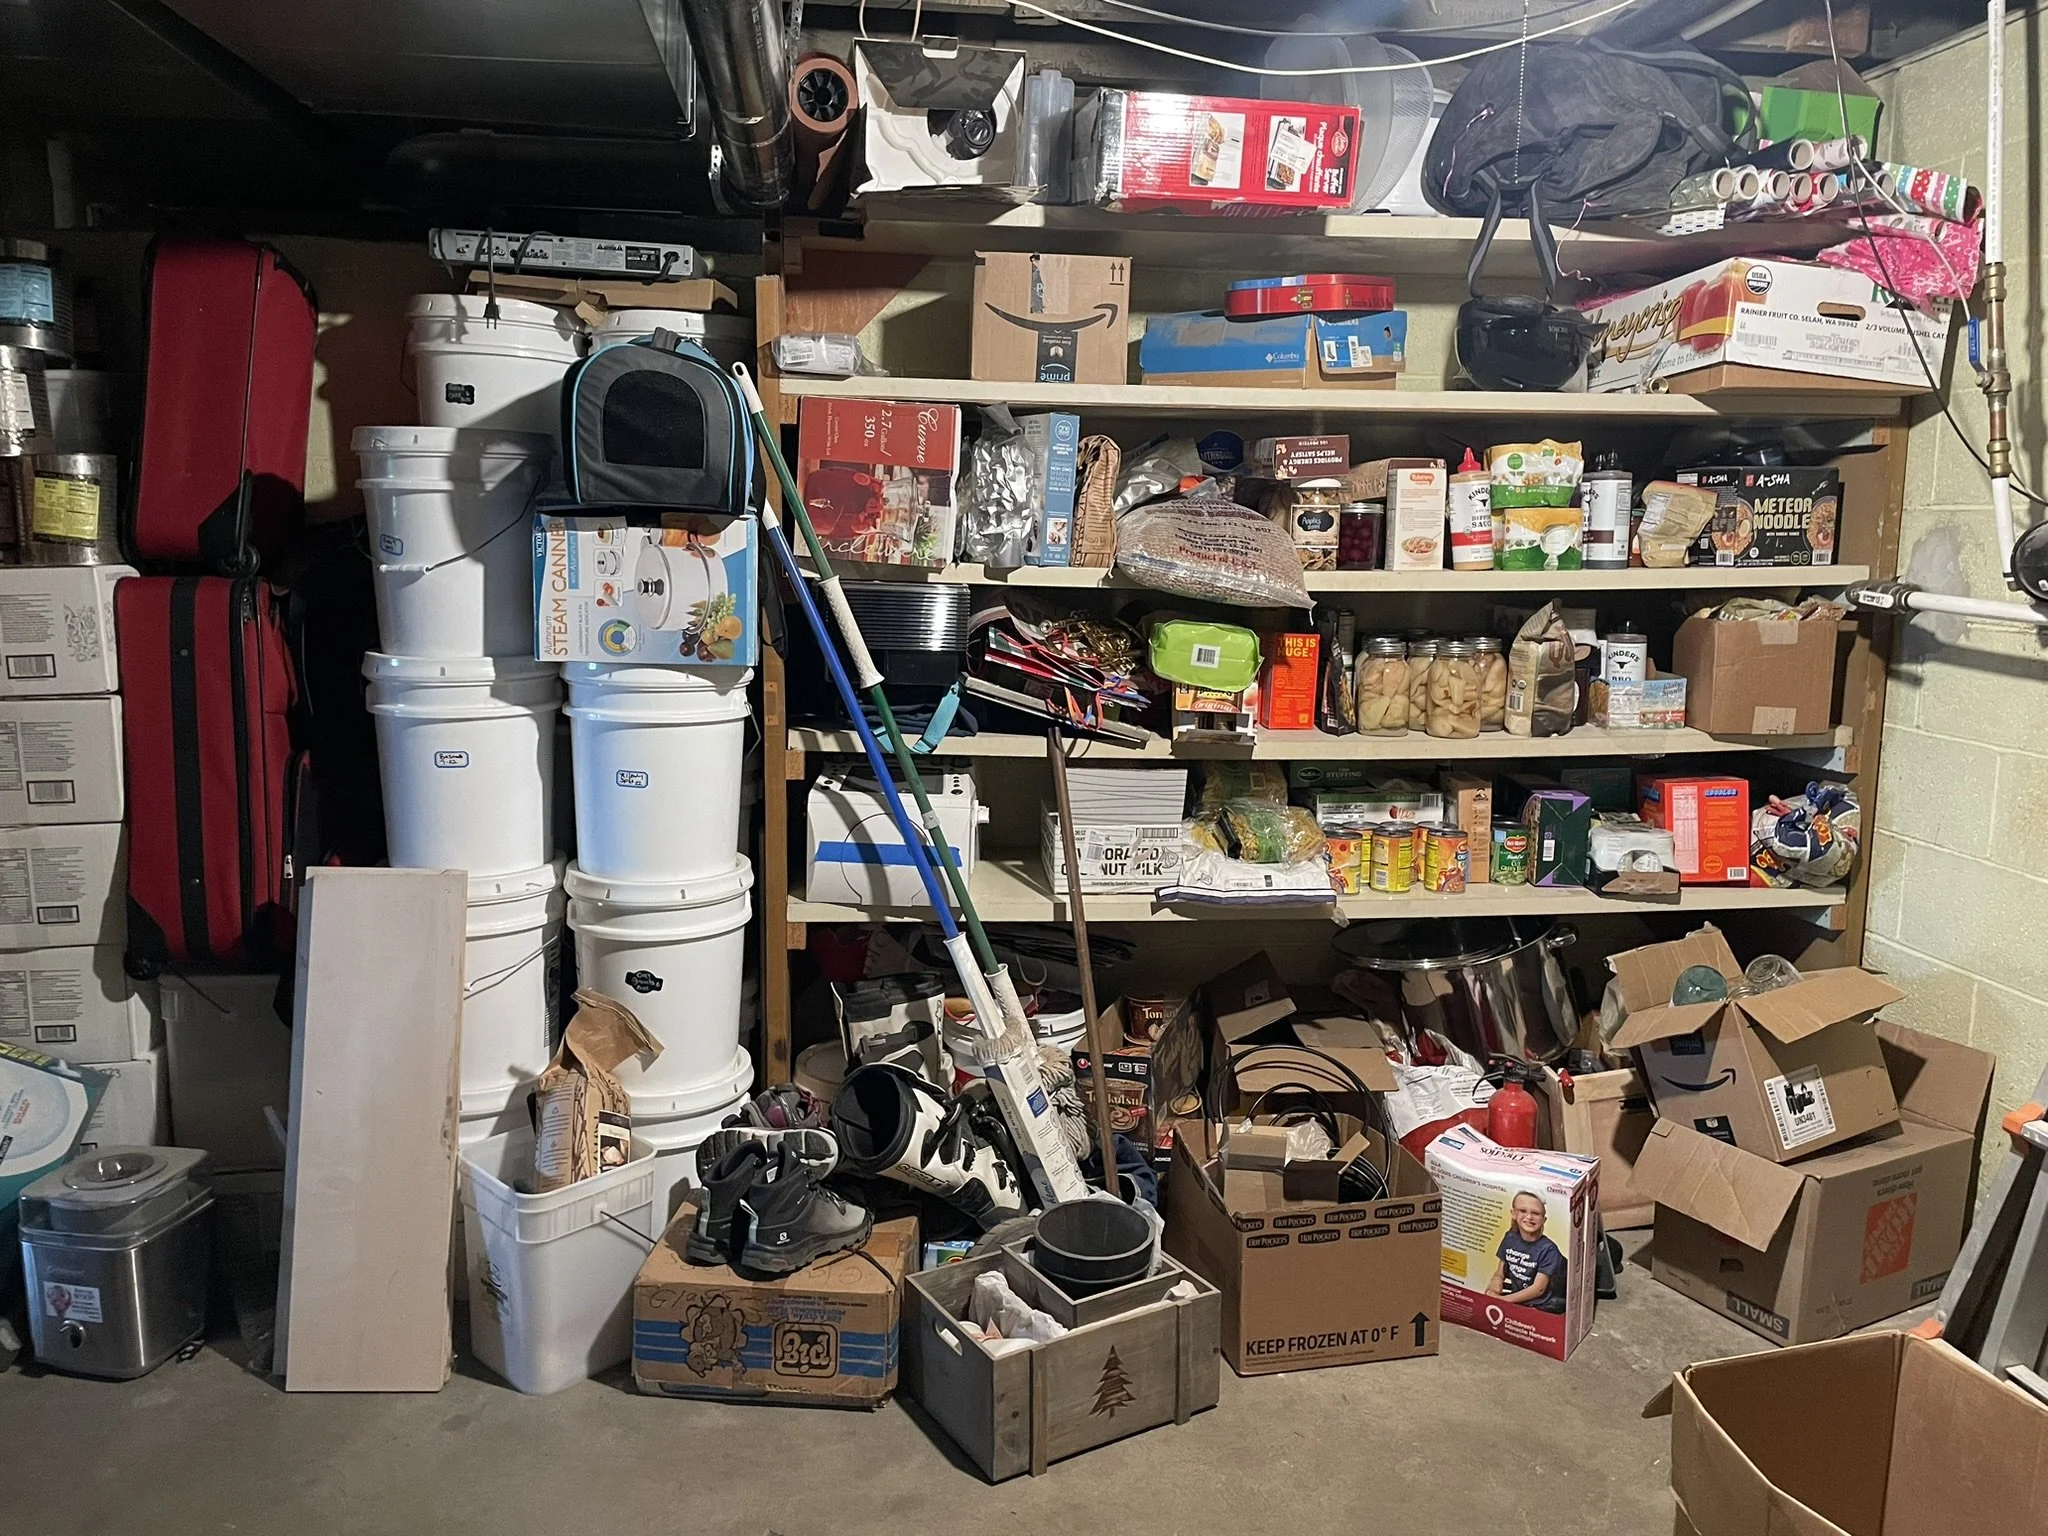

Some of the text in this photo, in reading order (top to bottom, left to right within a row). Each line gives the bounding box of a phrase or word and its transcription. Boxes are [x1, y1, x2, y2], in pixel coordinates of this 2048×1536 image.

[1313, 121, 1328, 193] Plaque chauffante
[1322, 168, 1331, 194] Server
[1329, 168, 1339, 194] Buffet
[1752, 272, 1767, 281] USDA
[1740, 306, 1766, 318] RAINIER
[1768, 310, 1788, 320] FRUIT
[1789, 313, 1799, 322] CO.
[1801, 315, 1824, 327] SELAH,
[1825, 317, 1836, 327] WA
[1866, 323, 1946, 341] 2/3 VOLUME USHEL CAT.
[1273, 352, 1299, 361] Columbia
[1040, 371, 1071, 383] prime
[864, 415, 876, 439] 350
[881, 409, 893, 428] 2.7
[917, 407, 940, 465] Curve
[1289, 457, 1313, 465] ENERGY
[1290, 449, 1336, 458] HELPS SATISFY
[1313, 456, 1342, 464] PROVIDES
[1707, 474, 1728, 485] A-SHA
[1756, 473, 1791, 488] A-SHA
[1754, 497, 1813, 514] METEOR
[1471, 521, 1492, 529] SAUC
[1753, 513, 1812, 530] NOODLE
[1179, 546, 1217, 562] Product
[548, 521, 568, 656] STEAM CANNER
[544, 615, 553, 655] Aluminum
[1279, 637, 1317, 648] THIS IS
[1193, 700, 1234, 712] Original
[1794, 1112, 1817, 1128] UN3481
[1452, 1173, 1481, 1186] CHILDREN'S
[1482, 1182, 1507, 1193] HOSPITAL
[1731, 1296, 1785, 1333] SMALL
[1504, 1316, 1536, 1332] Children's
[1246, 1325, 1399, 1356] KEEP FROZEN AT 0° F
[1504, 1323, 1556, 1344] Miracle Network
[1504, 1329, 1534, 1343] Hospitals
